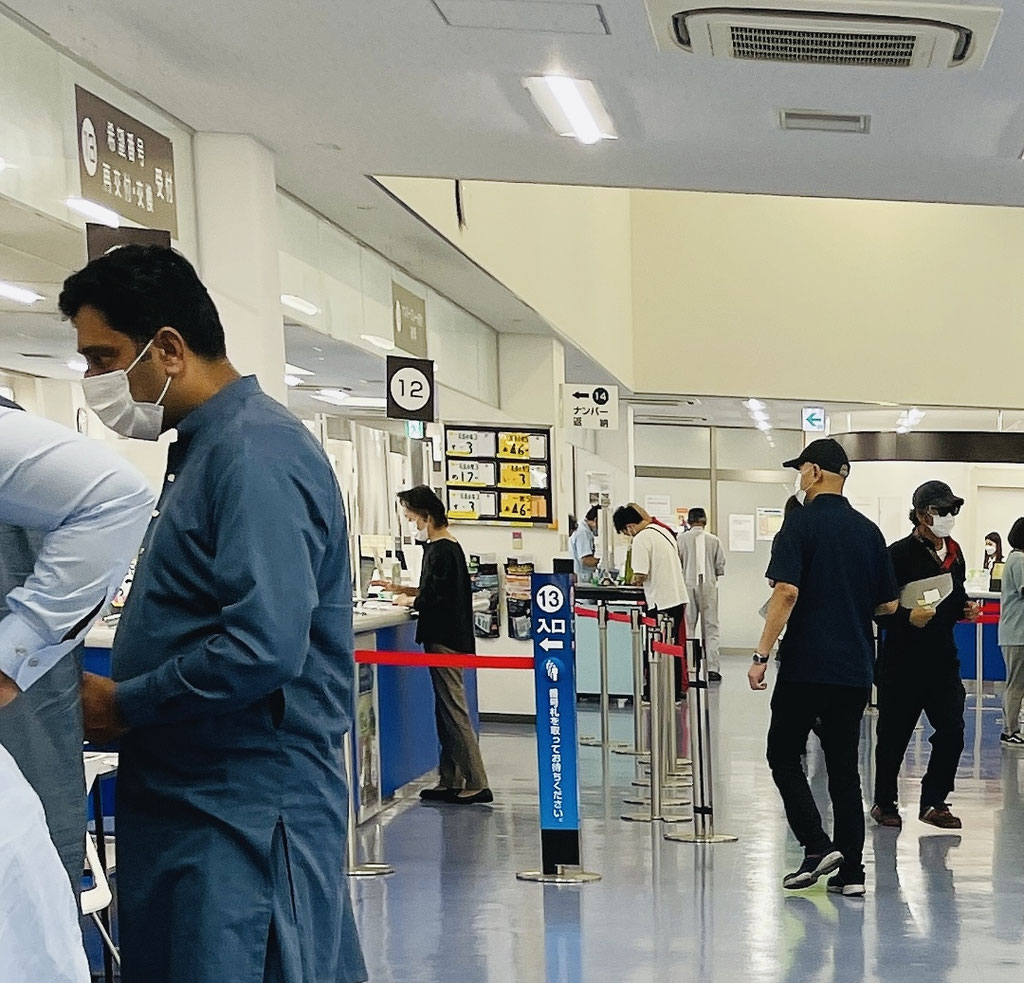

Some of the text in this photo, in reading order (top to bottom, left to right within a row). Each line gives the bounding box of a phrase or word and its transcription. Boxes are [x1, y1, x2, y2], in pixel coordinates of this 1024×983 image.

[398, 379, 424, 399] 12
[594, 391, 607, 401] 14
[573, 406, 609, 416] ナンバー
[539, 590, 560, 608] 13
[536, 618, 566, 634] 入口
